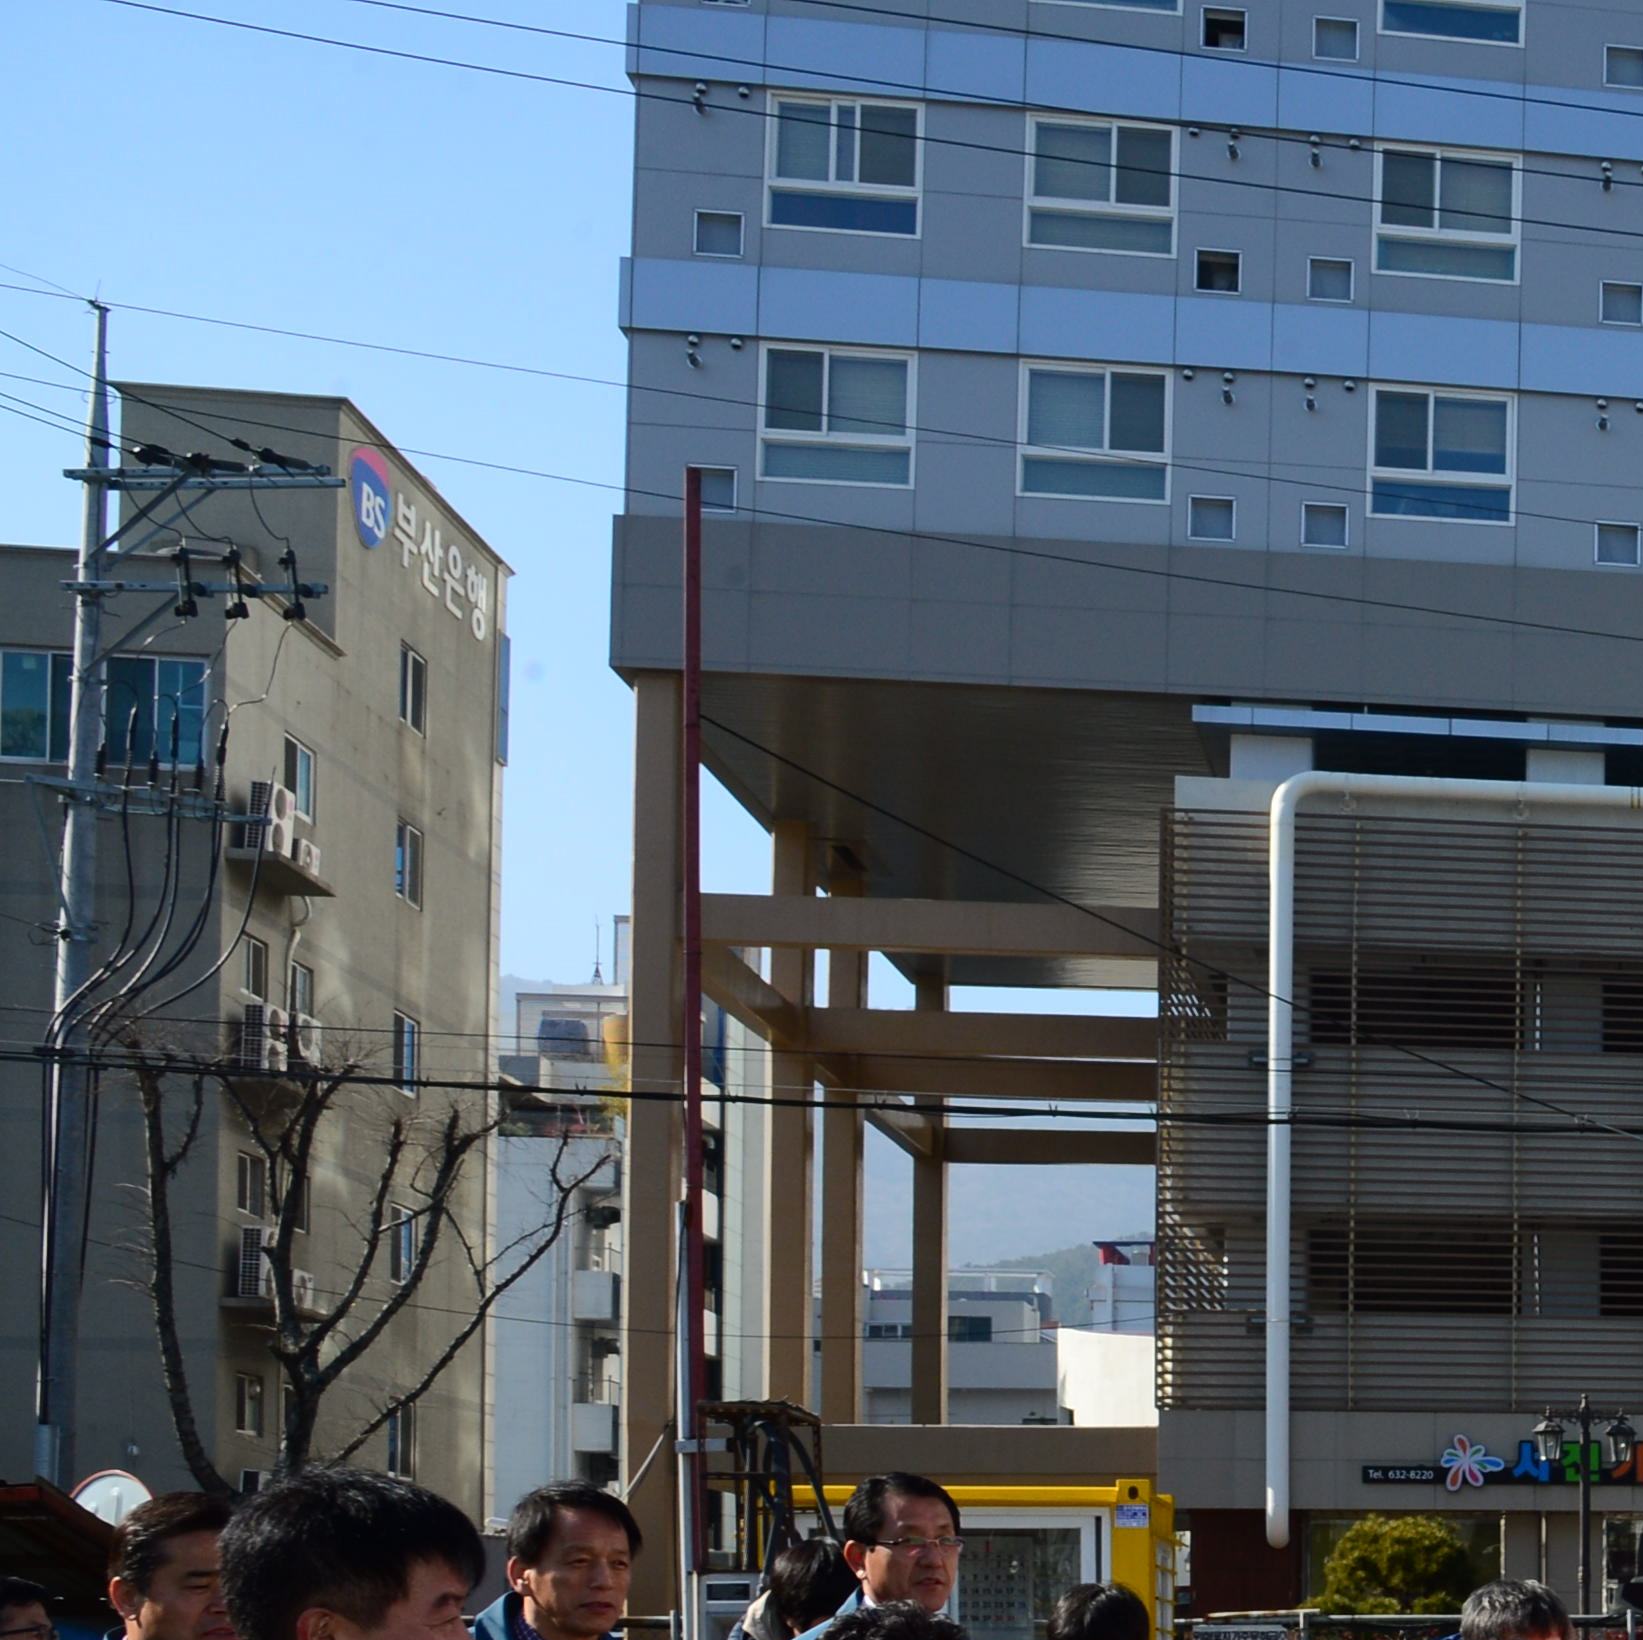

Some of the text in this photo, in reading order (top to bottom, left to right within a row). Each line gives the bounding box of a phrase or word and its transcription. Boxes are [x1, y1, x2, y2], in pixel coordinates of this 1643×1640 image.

[361, 482, 386, 540] BS
[392, 492, 488, 641] 부산은행
[1367, 1469, 1434, 1480] Tel. 632-8220
